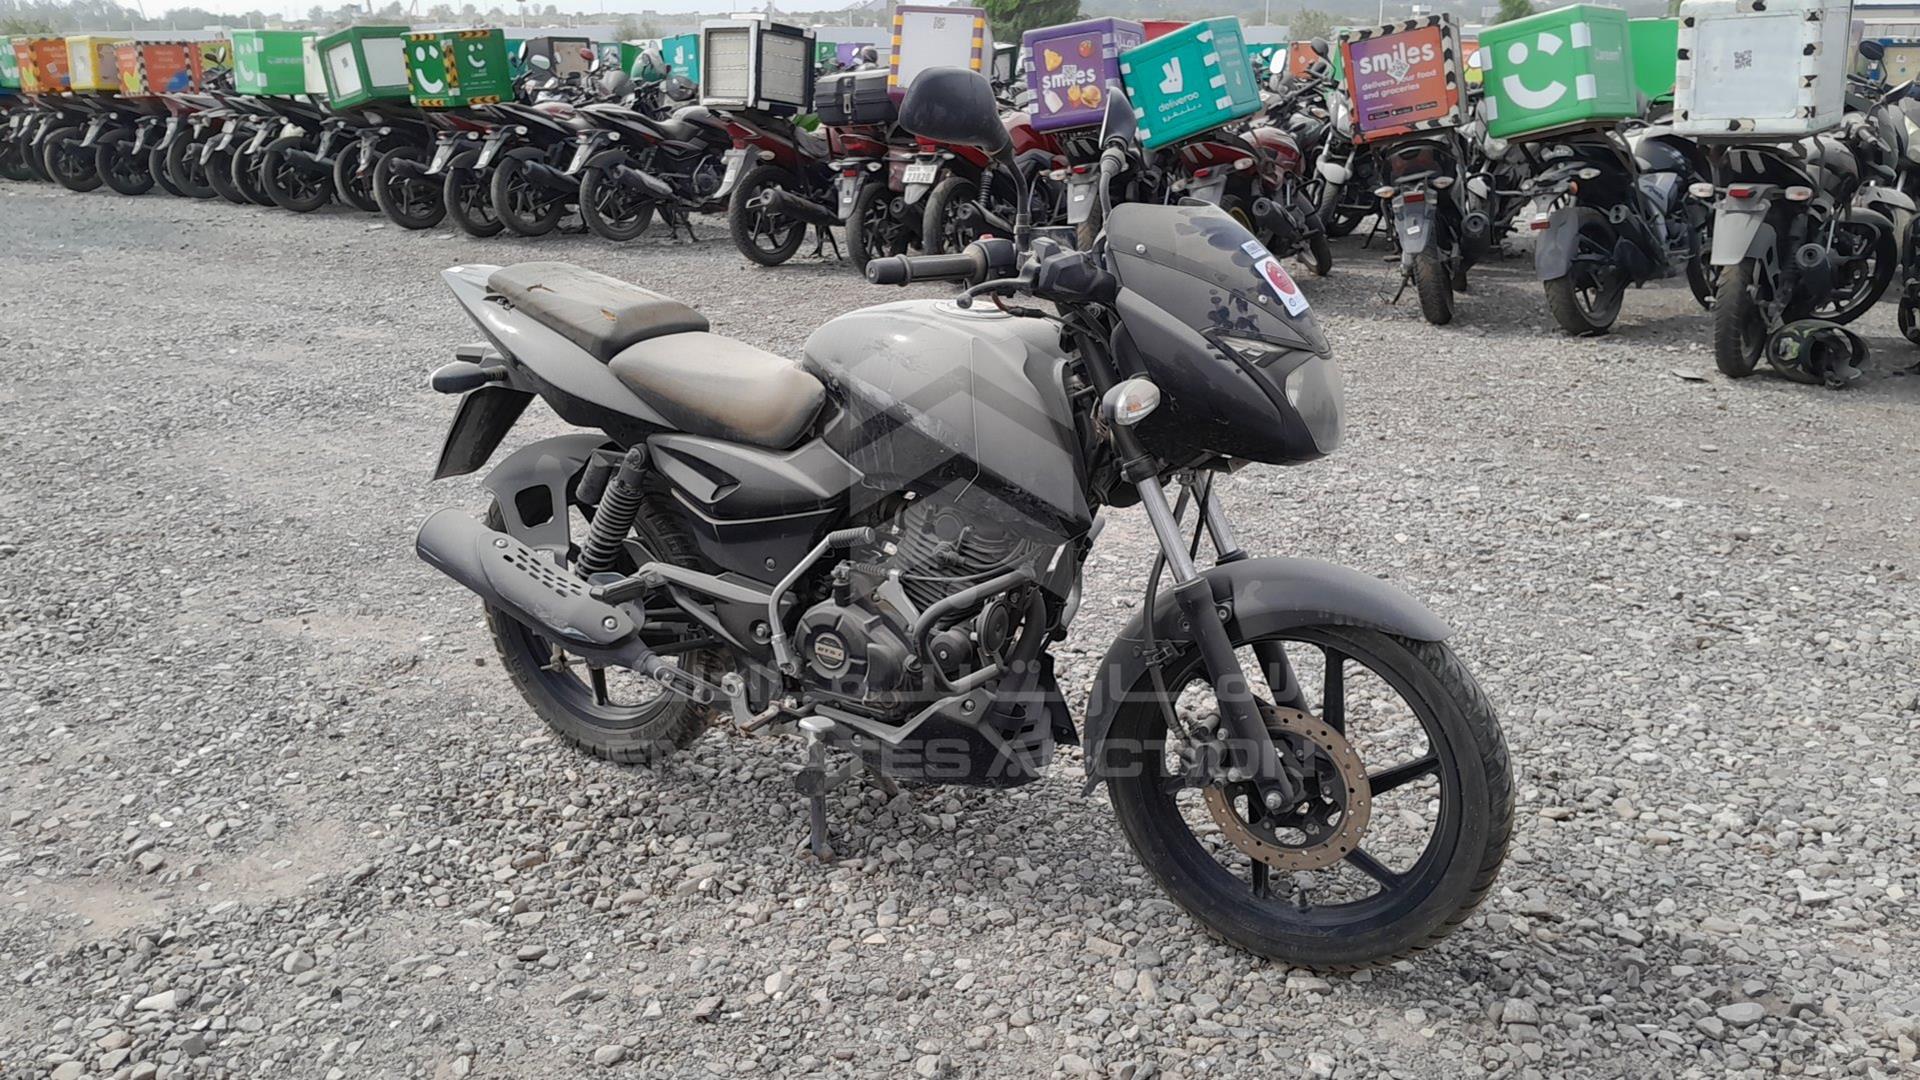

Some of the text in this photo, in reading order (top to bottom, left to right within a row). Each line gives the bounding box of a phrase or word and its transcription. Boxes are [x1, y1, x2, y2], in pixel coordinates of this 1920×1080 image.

[1360, 42, 1434, 74] smiles
[1042, 68, 1097, 89] smes
[1416, 69, 1437, 79] food
[1158, 91, 1200, 112] deliveroo
[1362, 91, 1379, 100] and
